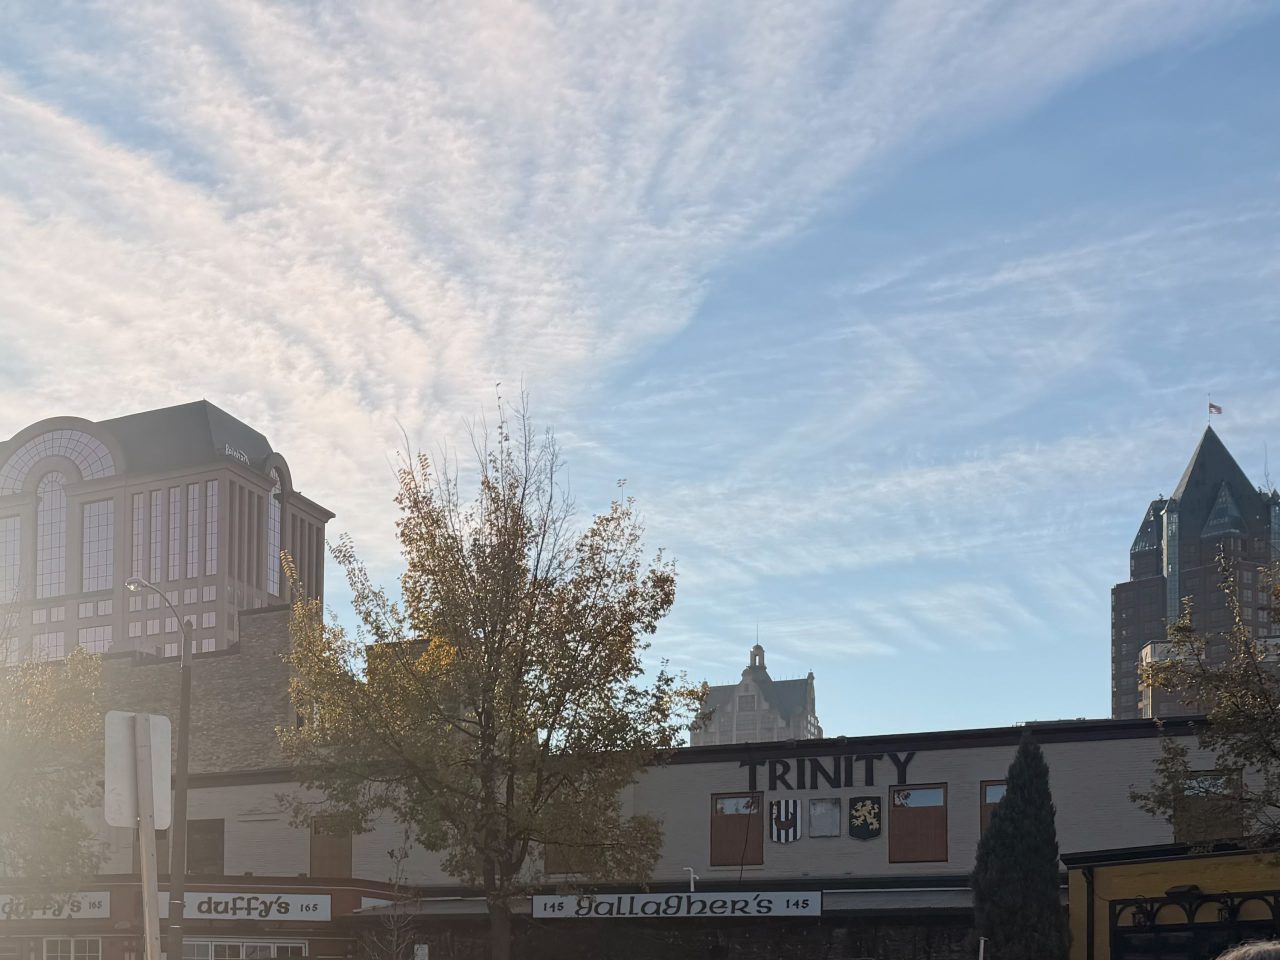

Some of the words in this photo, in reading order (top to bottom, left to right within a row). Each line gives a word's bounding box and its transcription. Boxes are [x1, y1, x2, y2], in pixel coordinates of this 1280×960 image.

[738, 752, 916, 791] TRINITY
[88, 900, 103, 910] 165
[197, 896, 291, 919] duffy's
[300, 903, 319, 912] 165
[543, 902, 565, 912] 145
[785, 898, 810, 910] 145
